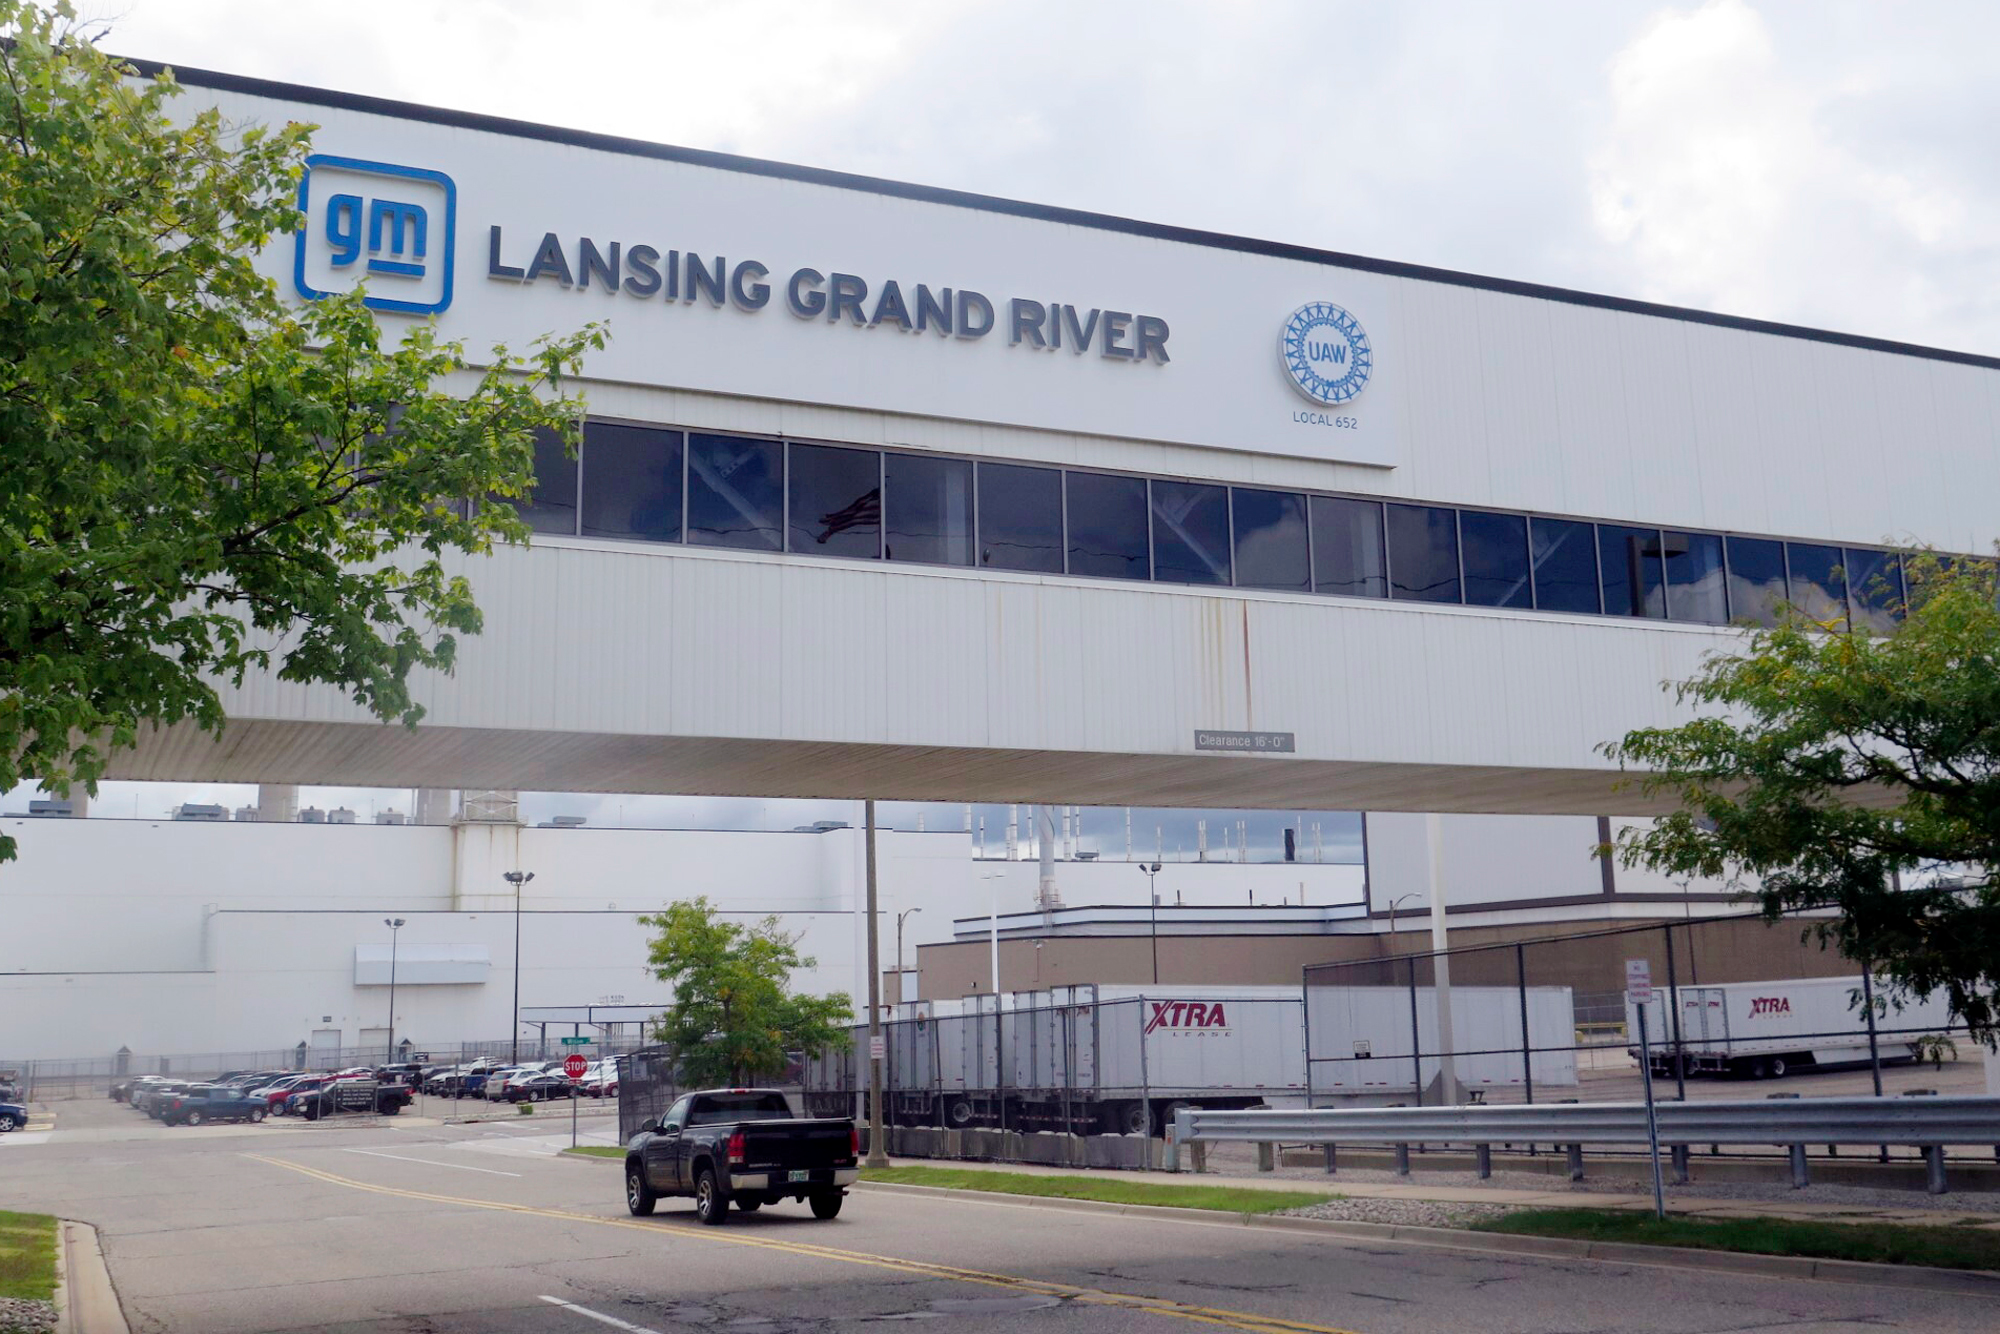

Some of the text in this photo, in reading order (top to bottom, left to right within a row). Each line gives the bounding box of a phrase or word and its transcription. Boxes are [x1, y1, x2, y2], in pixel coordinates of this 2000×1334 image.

[326, 194, 428, 277] gm
[487, 225, 1171, 365] LANSING GRAND RIVER
[1308, 341, 1347, 364] UAW
[1293, 411, 1358, 429] LOCAL 652
[1199, 734, 1251, 746] Clearance
[1144, 1000, 1226, 1034] XTRA
[1748, 997, 1790, 1018] XTRA
[565, 1061, 587, 1071] STOP
